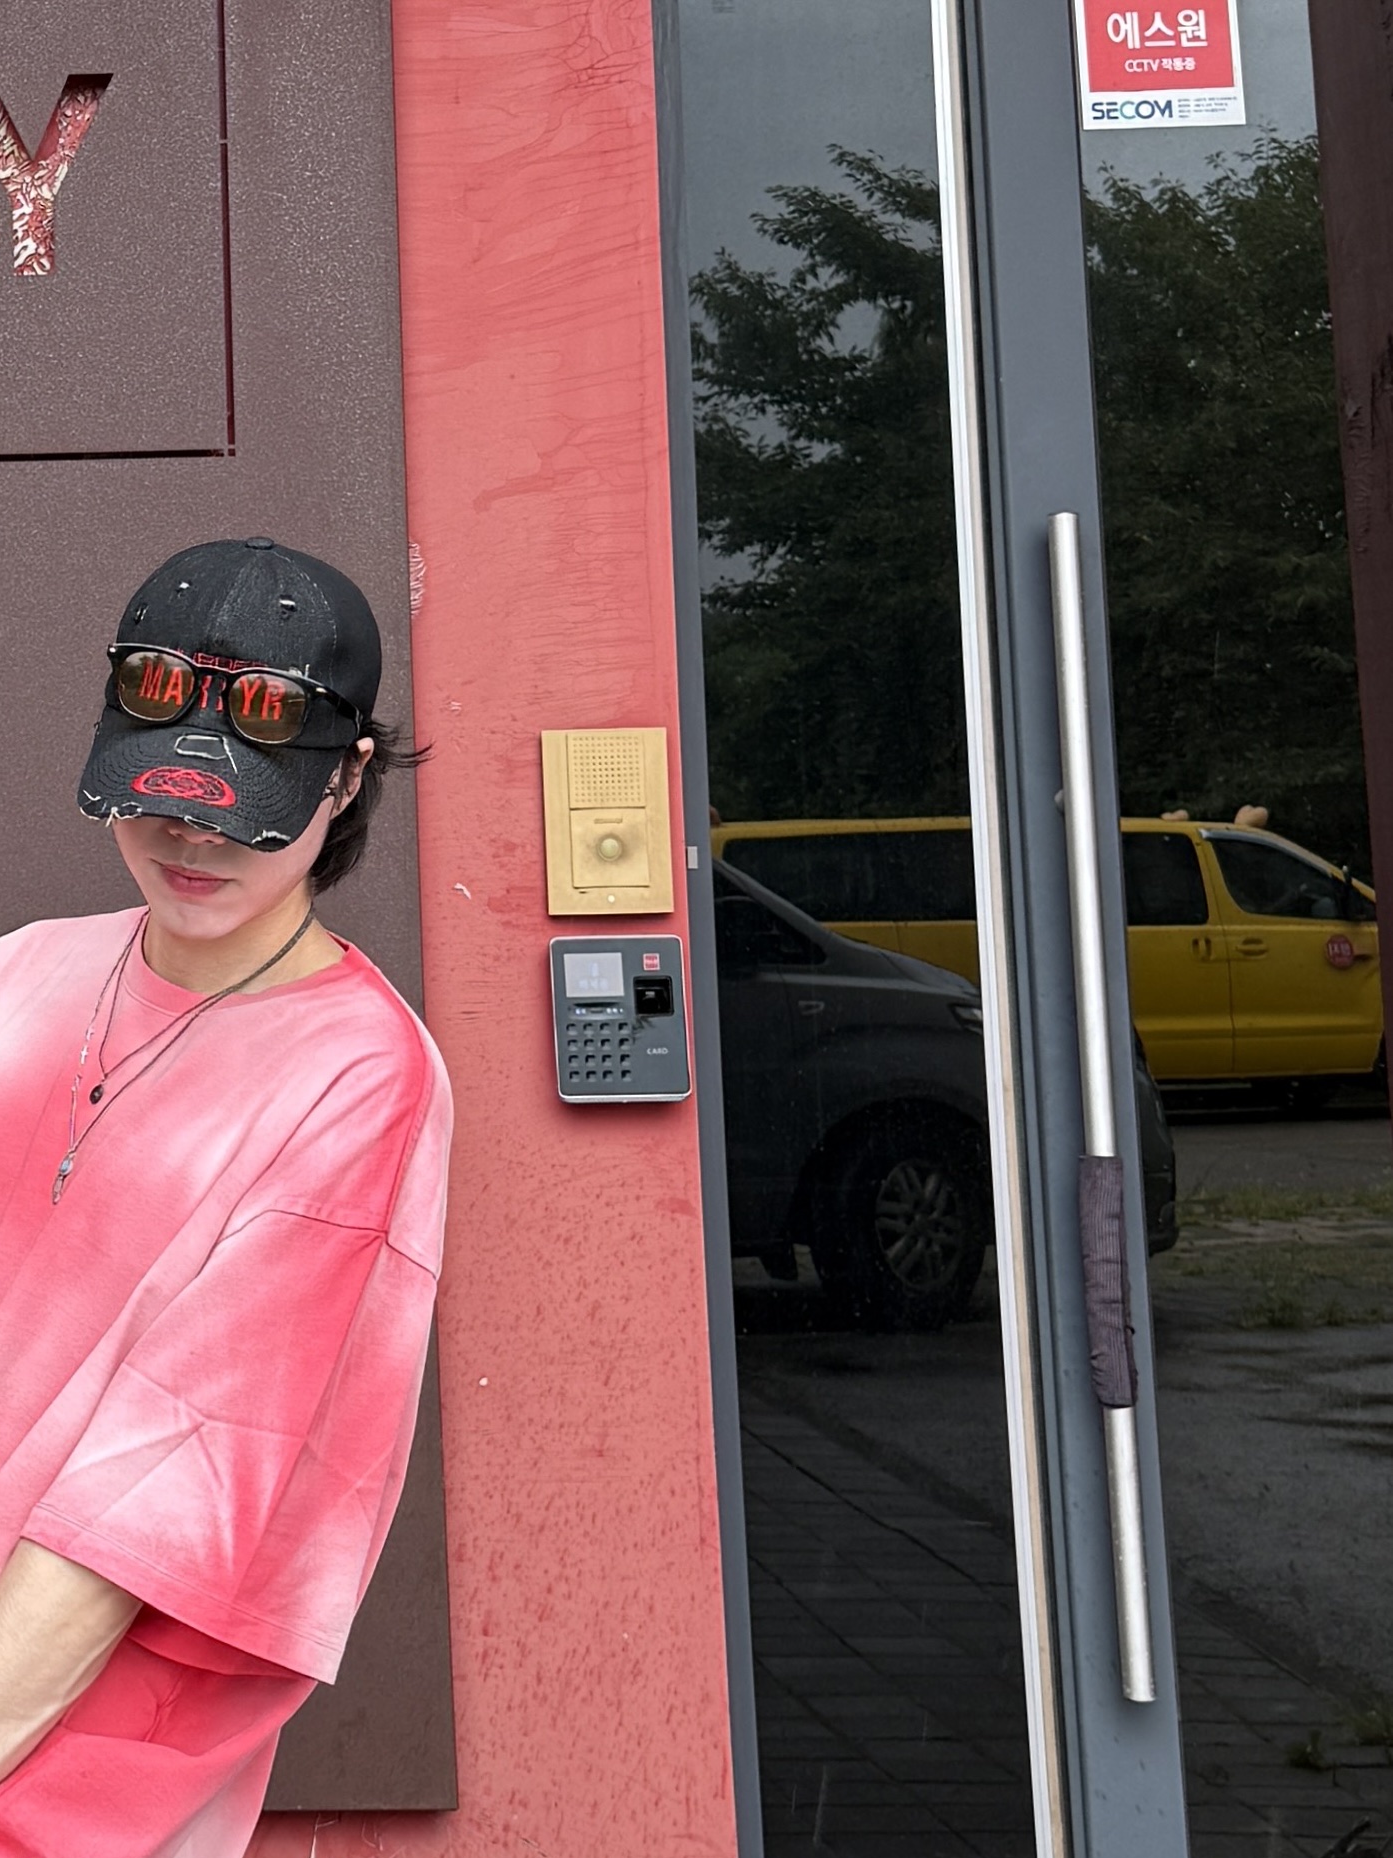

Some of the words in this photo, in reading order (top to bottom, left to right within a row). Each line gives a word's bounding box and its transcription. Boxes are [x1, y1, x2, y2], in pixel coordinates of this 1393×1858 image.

[1106, 9, 1208, 50] 에스원
[1124, 58, 1159, 72] CCTV
[1091, 99, 1173, 120] SECOM
